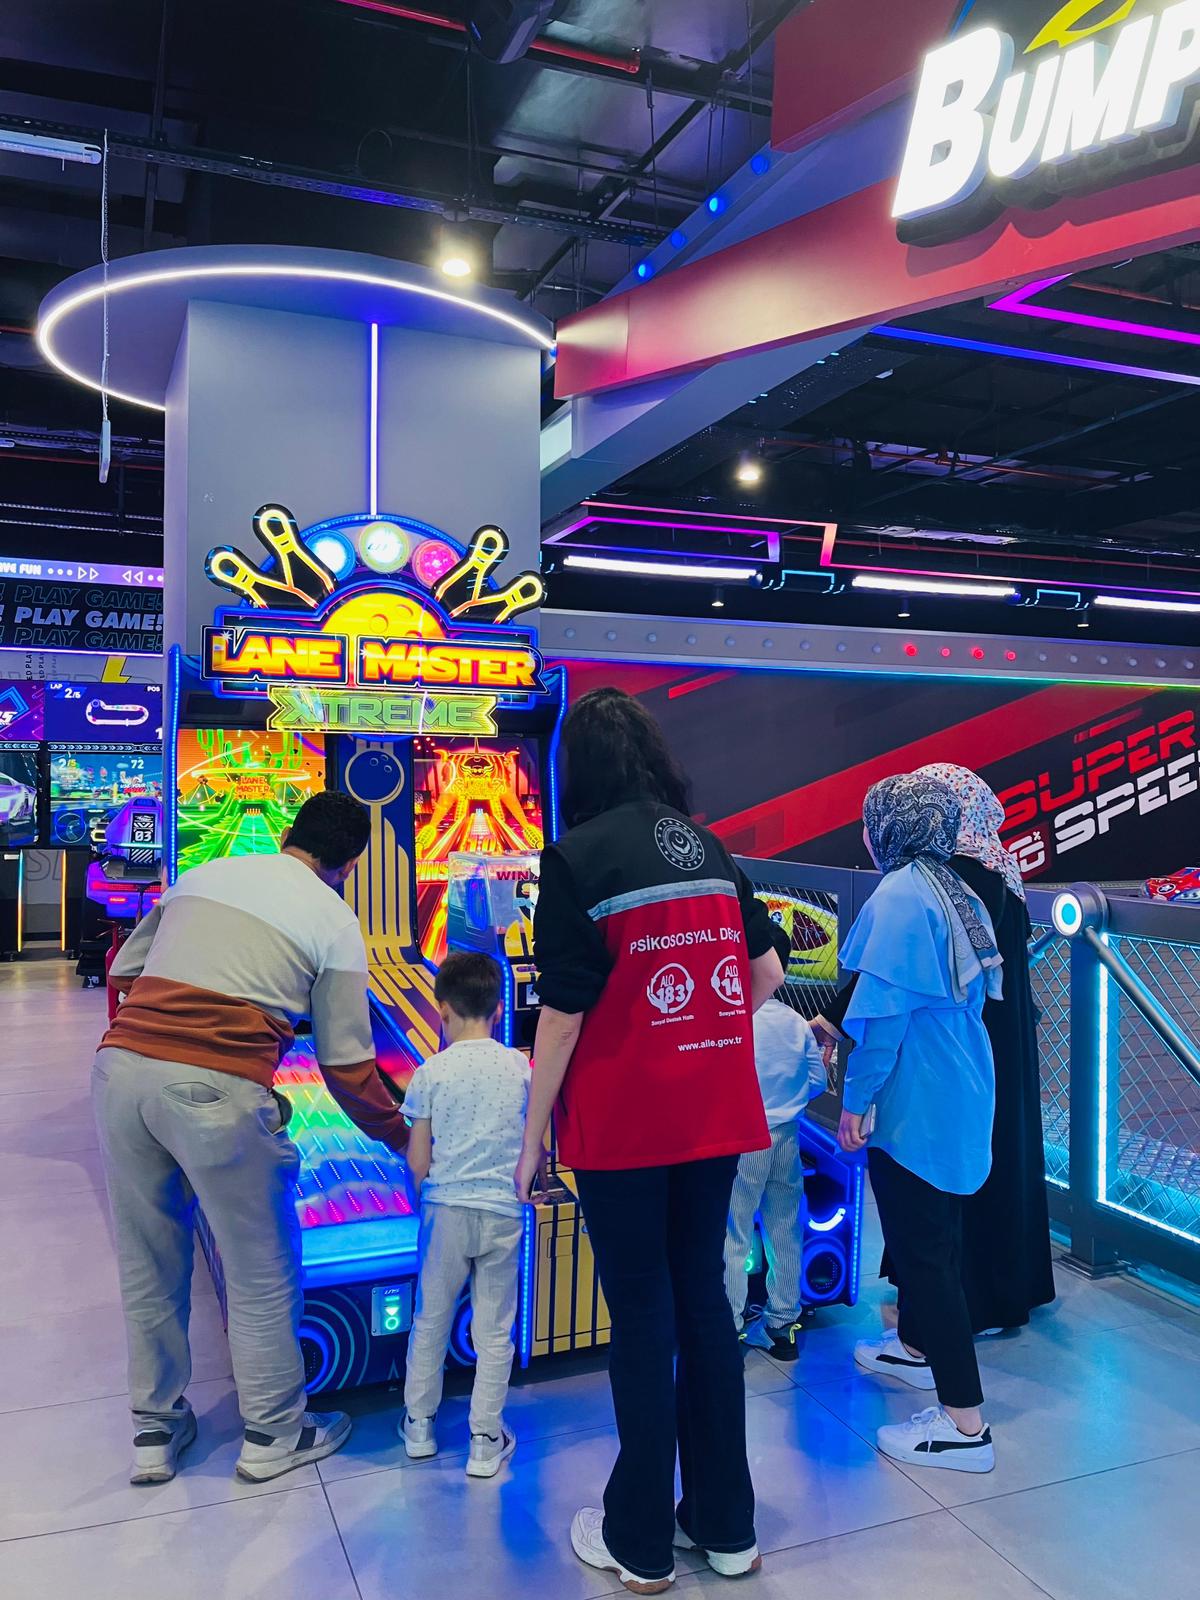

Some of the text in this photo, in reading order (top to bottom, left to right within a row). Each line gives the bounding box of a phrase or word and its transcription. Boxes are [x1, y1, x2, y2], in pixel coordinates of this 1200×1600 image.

[891, 0, 1200, 218] BUMP
[19, 563, 42, 576] FUN
[14, 584, 81, 606] PLAY
[85, 589, 163, 611] GAME!
[14, 606, 80, 626] PLAY
[85, 610, 163, 631] GAME!
[13, 627, 80, 648] PLAY
[84, 630, 163, 651] GAME!
[211, 634, 537, 687] LANE MASTER
[50, 683, 63, 692] LAP
[64, 688, 81, 699] 2/5
[278, 689, 484, 727] XTREME
[130, 759, 145, 769] 72
[996, 710, 1196, 833] SUPER
[1054, 750, 1200, 855] SPEE
[496, 871, 529, 881] WIN
[660, 974, 675, 988] ALO
[724, 965, 739, 978] ALO
[655, 983, 686, 1004] 183
[677, 1035, 743, 1052] www.aile.gov.tr
